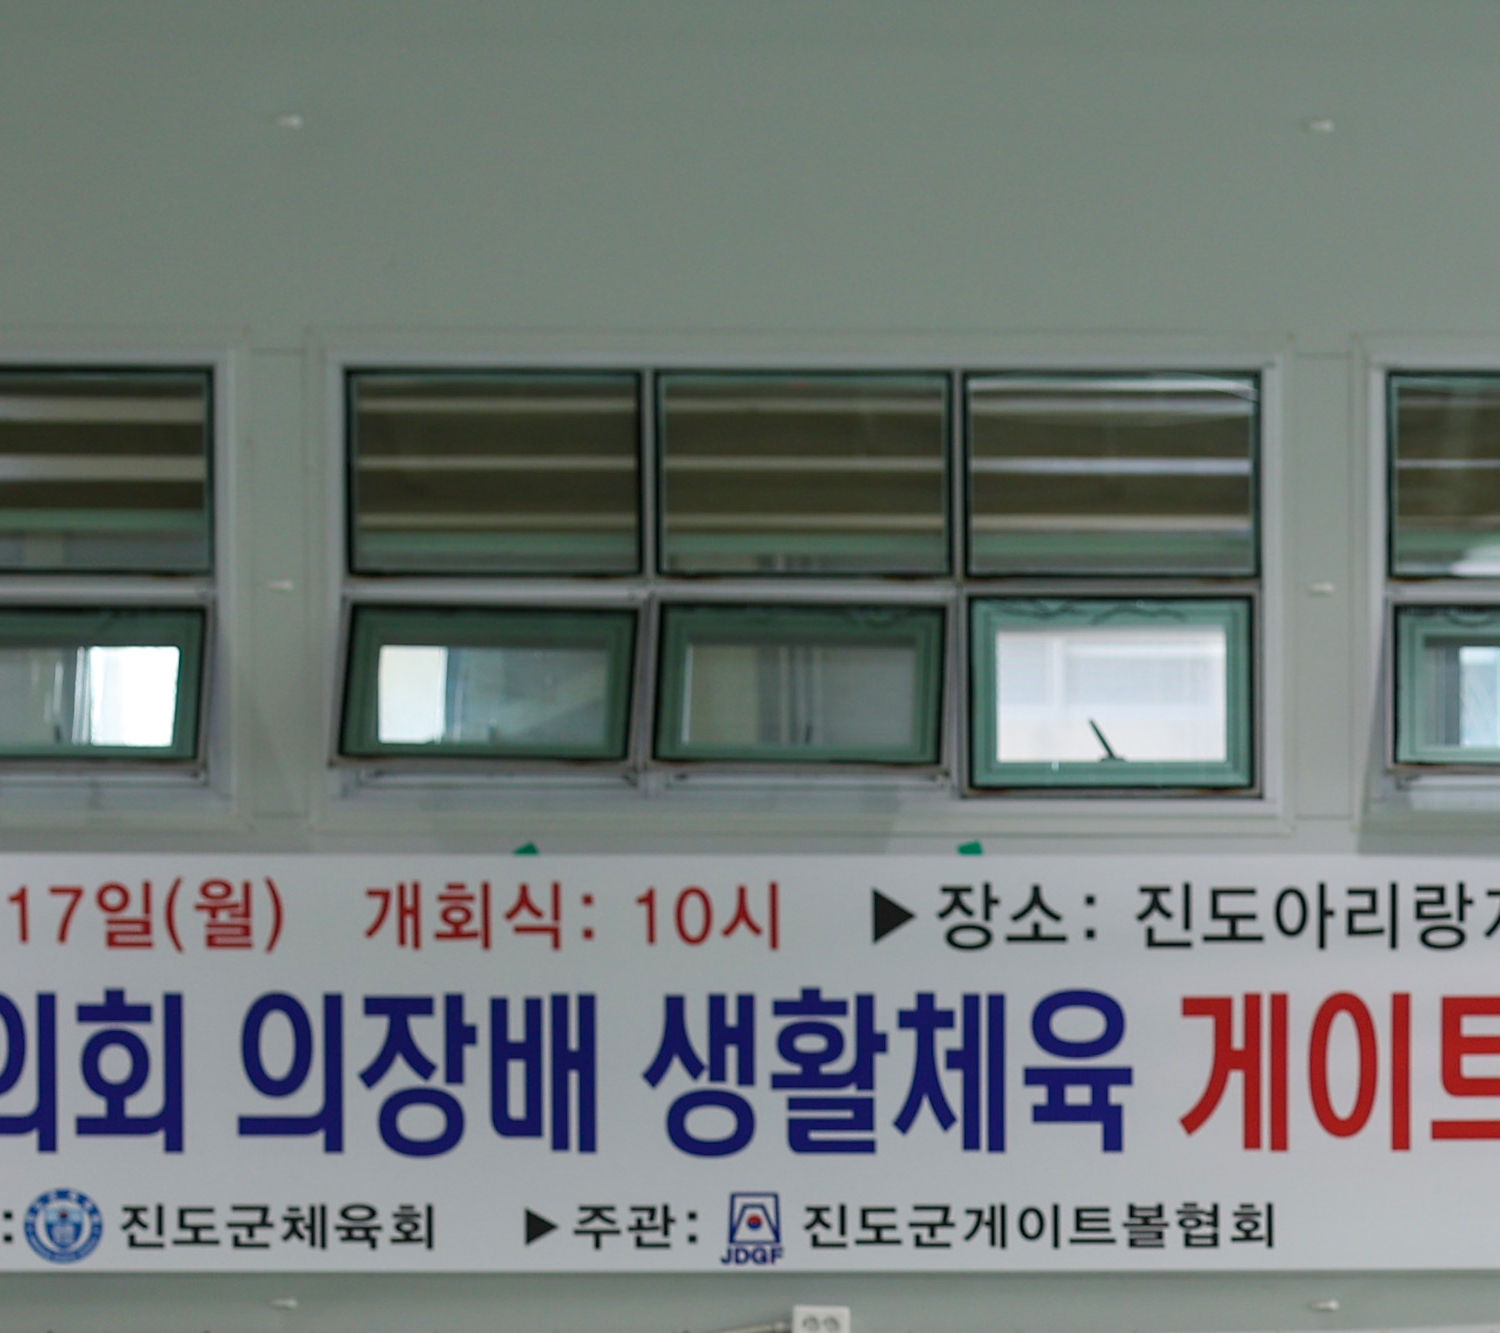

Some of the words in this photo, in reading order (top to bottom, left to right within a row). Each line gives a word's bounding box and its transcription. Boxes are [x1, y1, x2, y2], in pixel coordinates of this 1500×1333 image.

[7, 876, 285, 954] 17일(월)
[363, 879, 596, 952] 개회식:
[635, 880, 780, 952] 10시
[935, 881, 1097, 953] 장소:
[236, 989, 599, 1160] 의장배
[640, 985, 1134, 1160] 생활체육
[120, 1203, 434, 1251] 진도군체육회
[573, 1203, 698, 1251] 주관:
[803, 1202, 1274, 1251] 진도군게이트볼협회
[720, 1246, 784, 1266] JDGF
